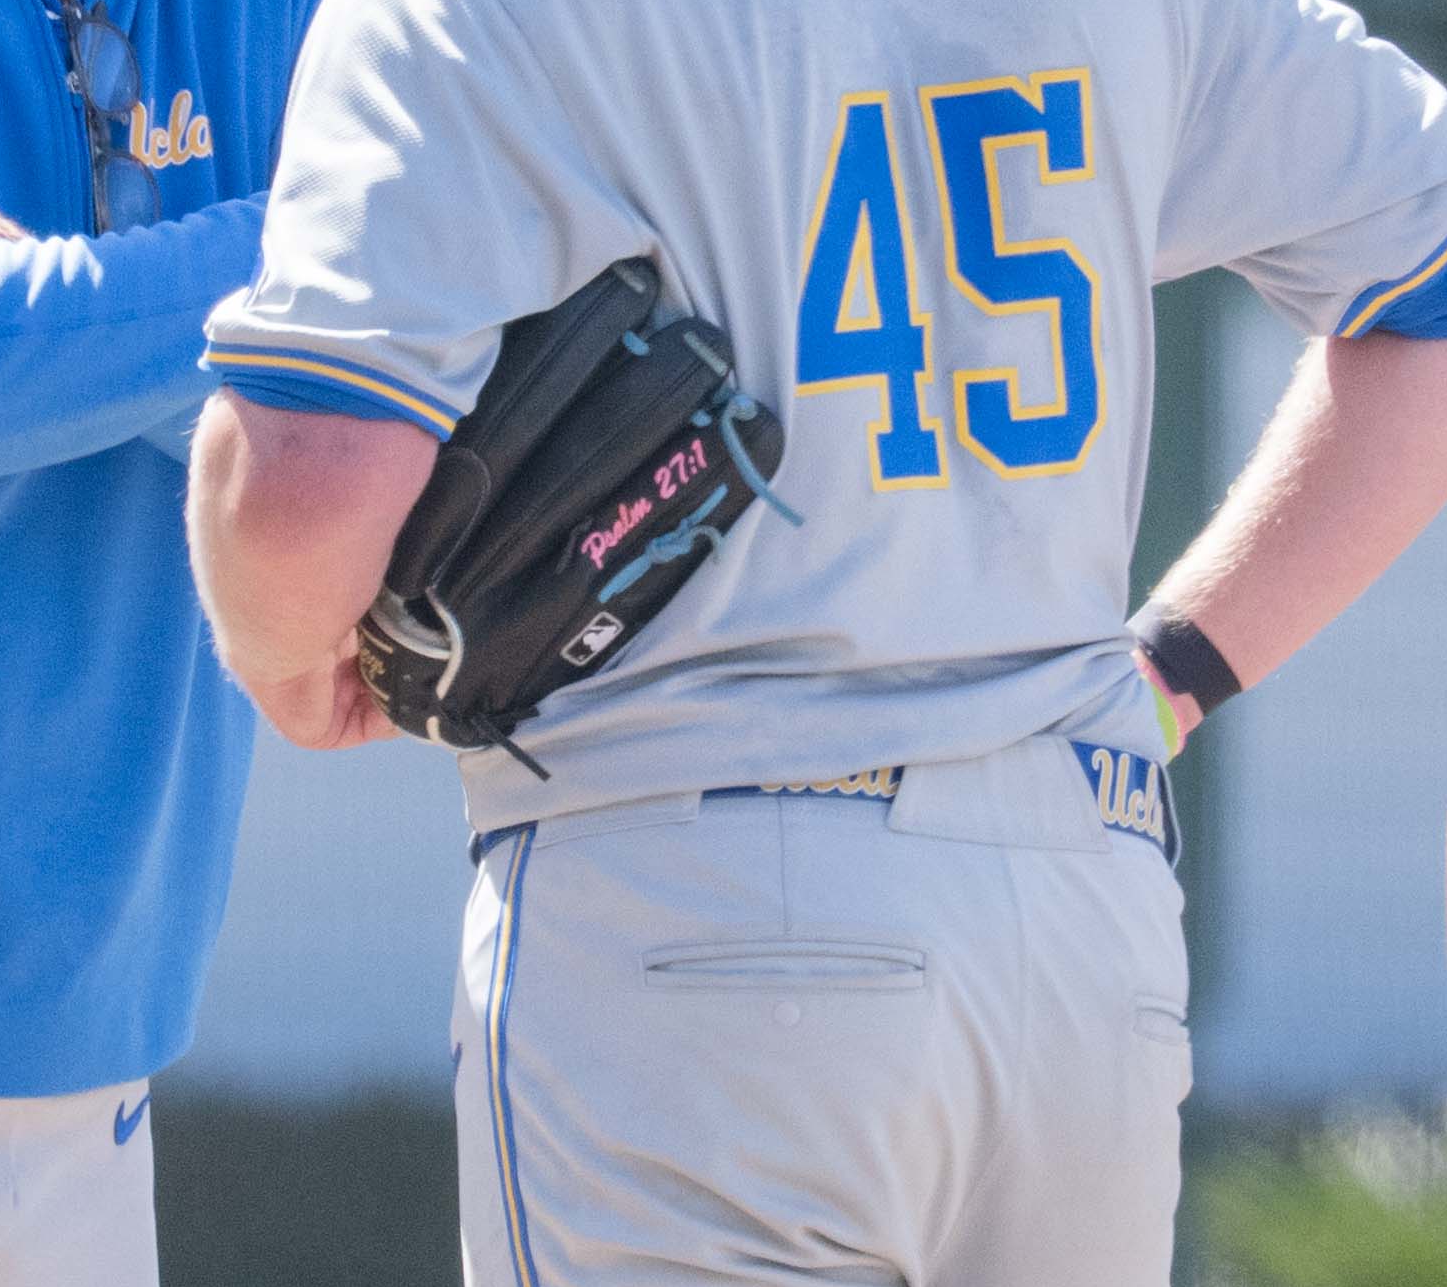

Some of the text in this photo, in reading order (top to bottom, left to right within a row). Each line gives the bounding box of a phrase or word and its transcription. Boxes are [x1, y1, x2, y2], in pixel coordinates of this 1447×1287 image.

[795, 67, 1107, 492] 45
[581, 438, 708, 570] Psalm 27:1
